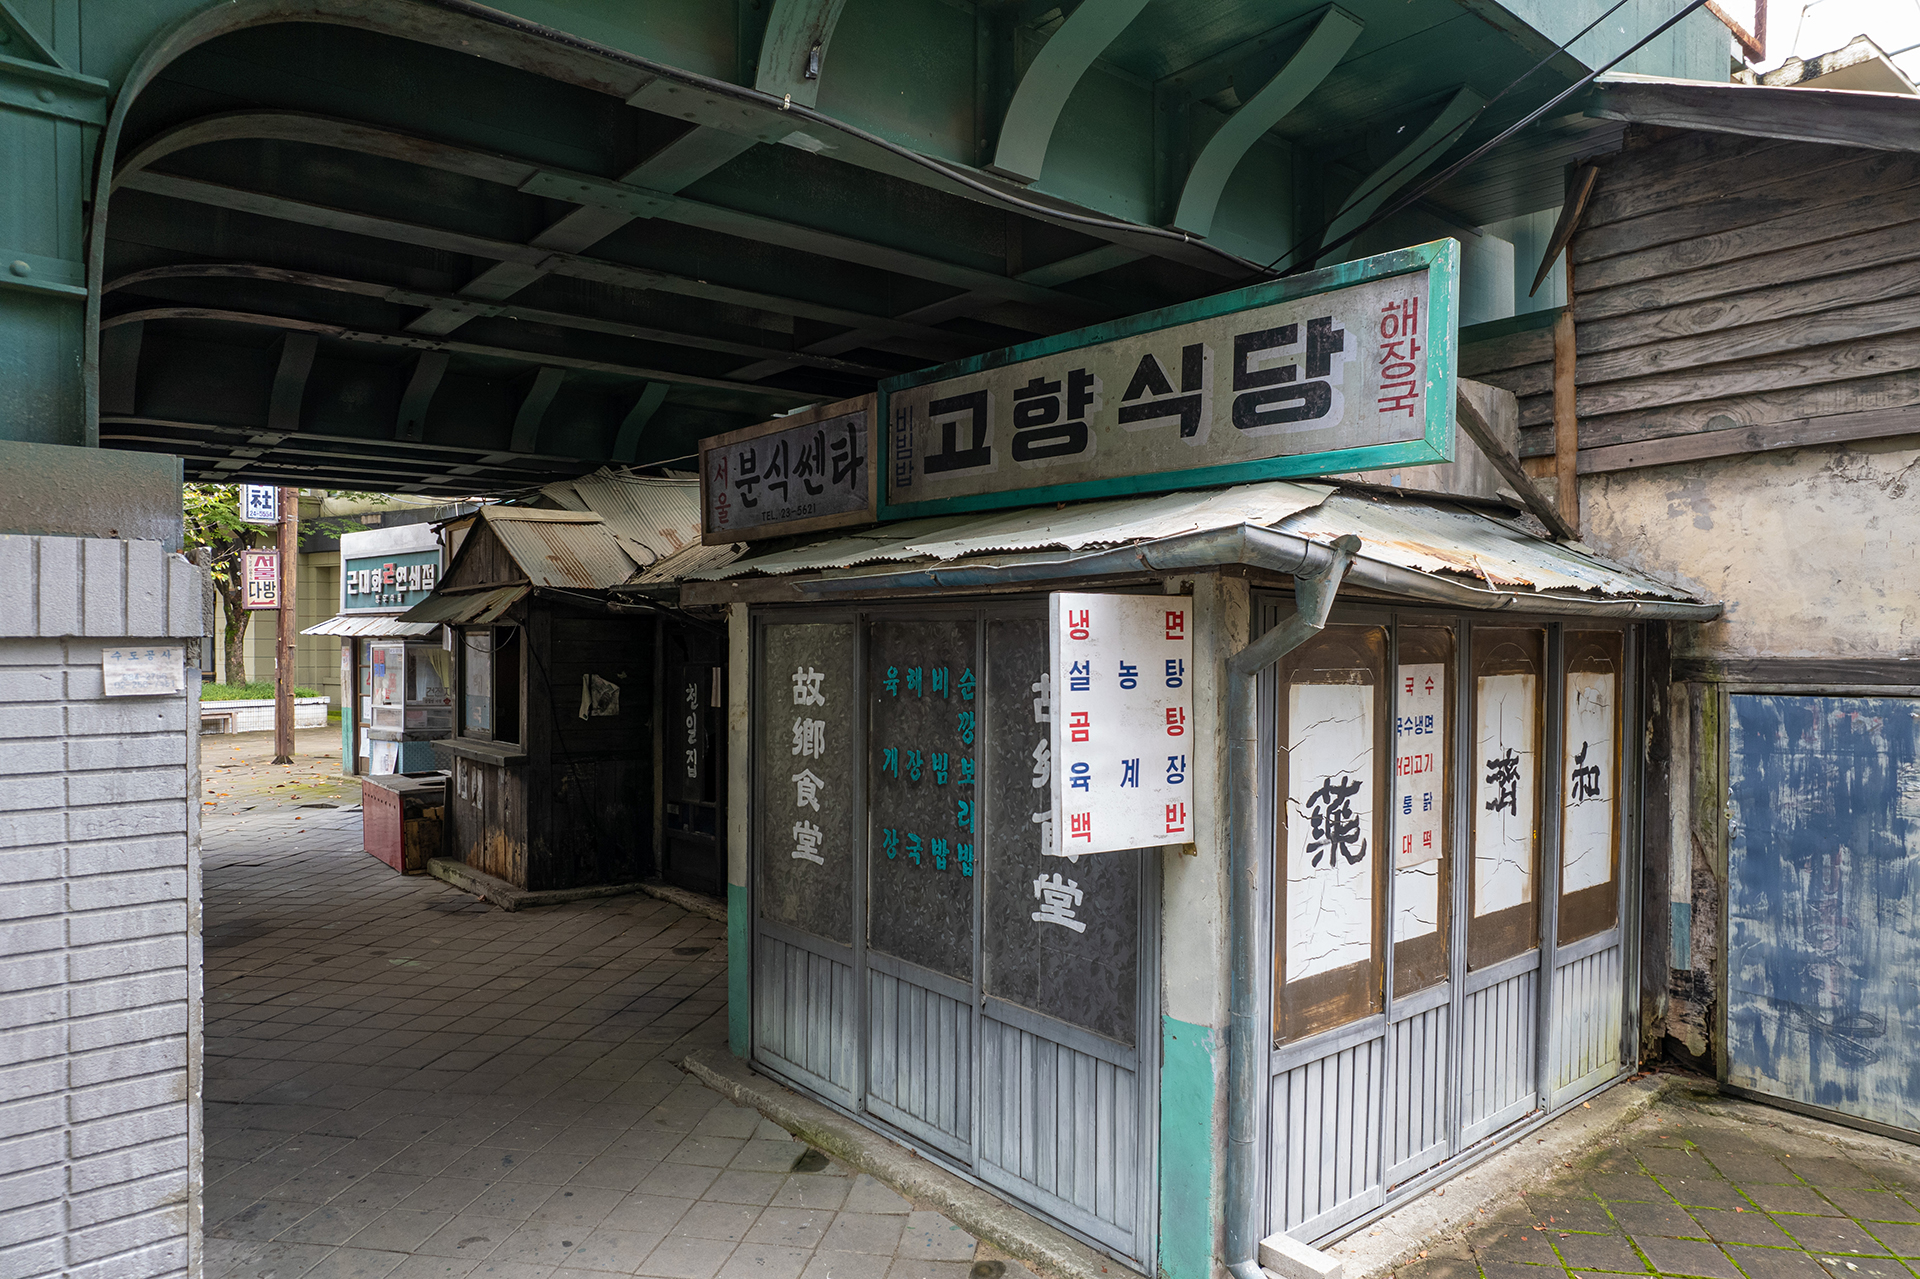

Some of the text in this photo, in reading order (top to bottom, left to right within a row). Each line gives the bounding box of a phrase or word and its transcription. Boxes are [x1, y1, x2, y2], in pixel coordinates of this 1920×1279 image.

[1378, 297, 1421, 417] 해장국
[923, 316, 1345, 475] 고향식당
[896, 405, 914, 487] 비빔밥
[714, 422, 864, 524] 서울 분식쎈타
[250, 489, 272, 509] 社
[781, 503, 816, 519] 23-5621
[249, 581, 276, 598] 다방
[396, 564, 436, 591] 연쇄점
[1069, 609, 1184, 640] 냉면
[1069, 659, 1184, 691] 설농탕
[685, 683, 698, 778] 천일집
[1069, 706, 1185, 742] 곰탕
[1069, 755, 1186, 792] 육계장
[1071, 802, 1186, 842] 백반
